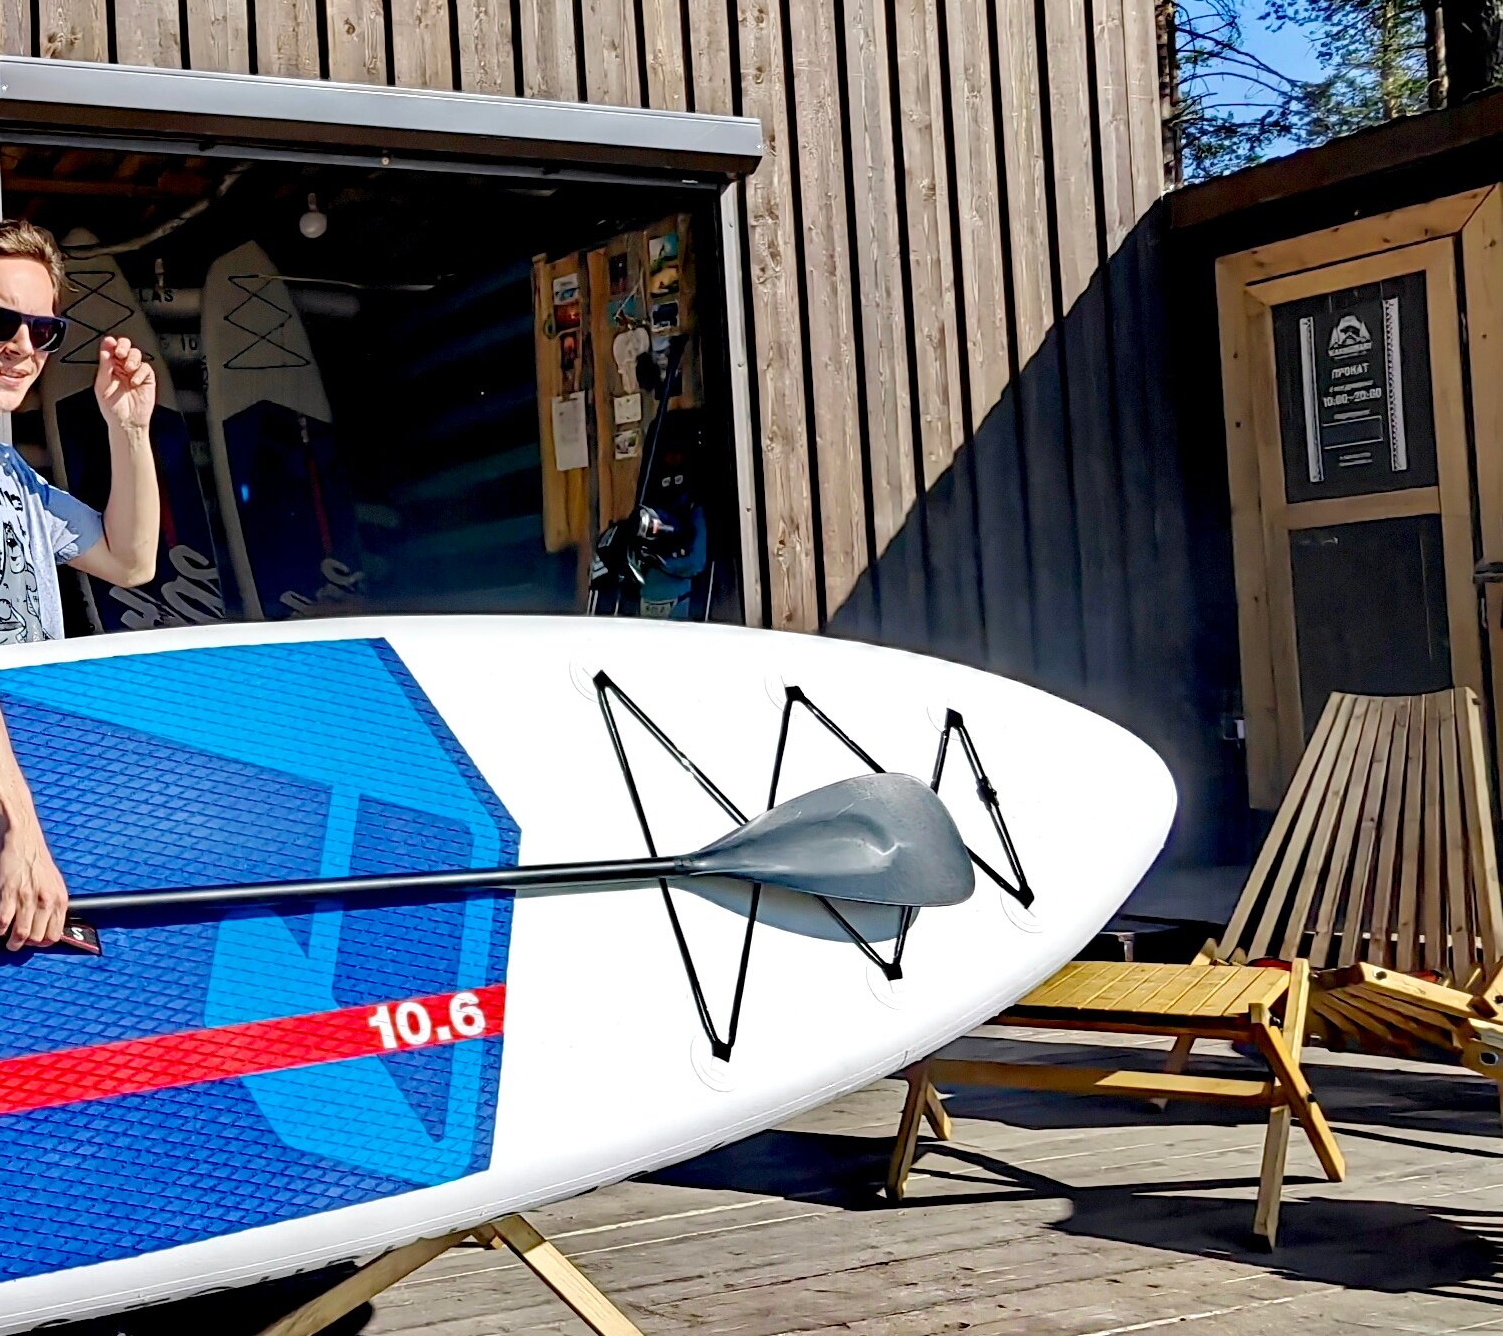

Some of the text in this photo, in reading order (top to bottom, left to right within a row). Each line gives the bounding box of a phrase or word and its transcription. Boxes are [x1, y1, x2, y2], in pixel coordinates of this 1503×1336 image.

[138, 288, 174, 303] LAS
[1331, 362, 1370, 380] ПРОКАТ
[368, 990, 487, 1050] 10.6
